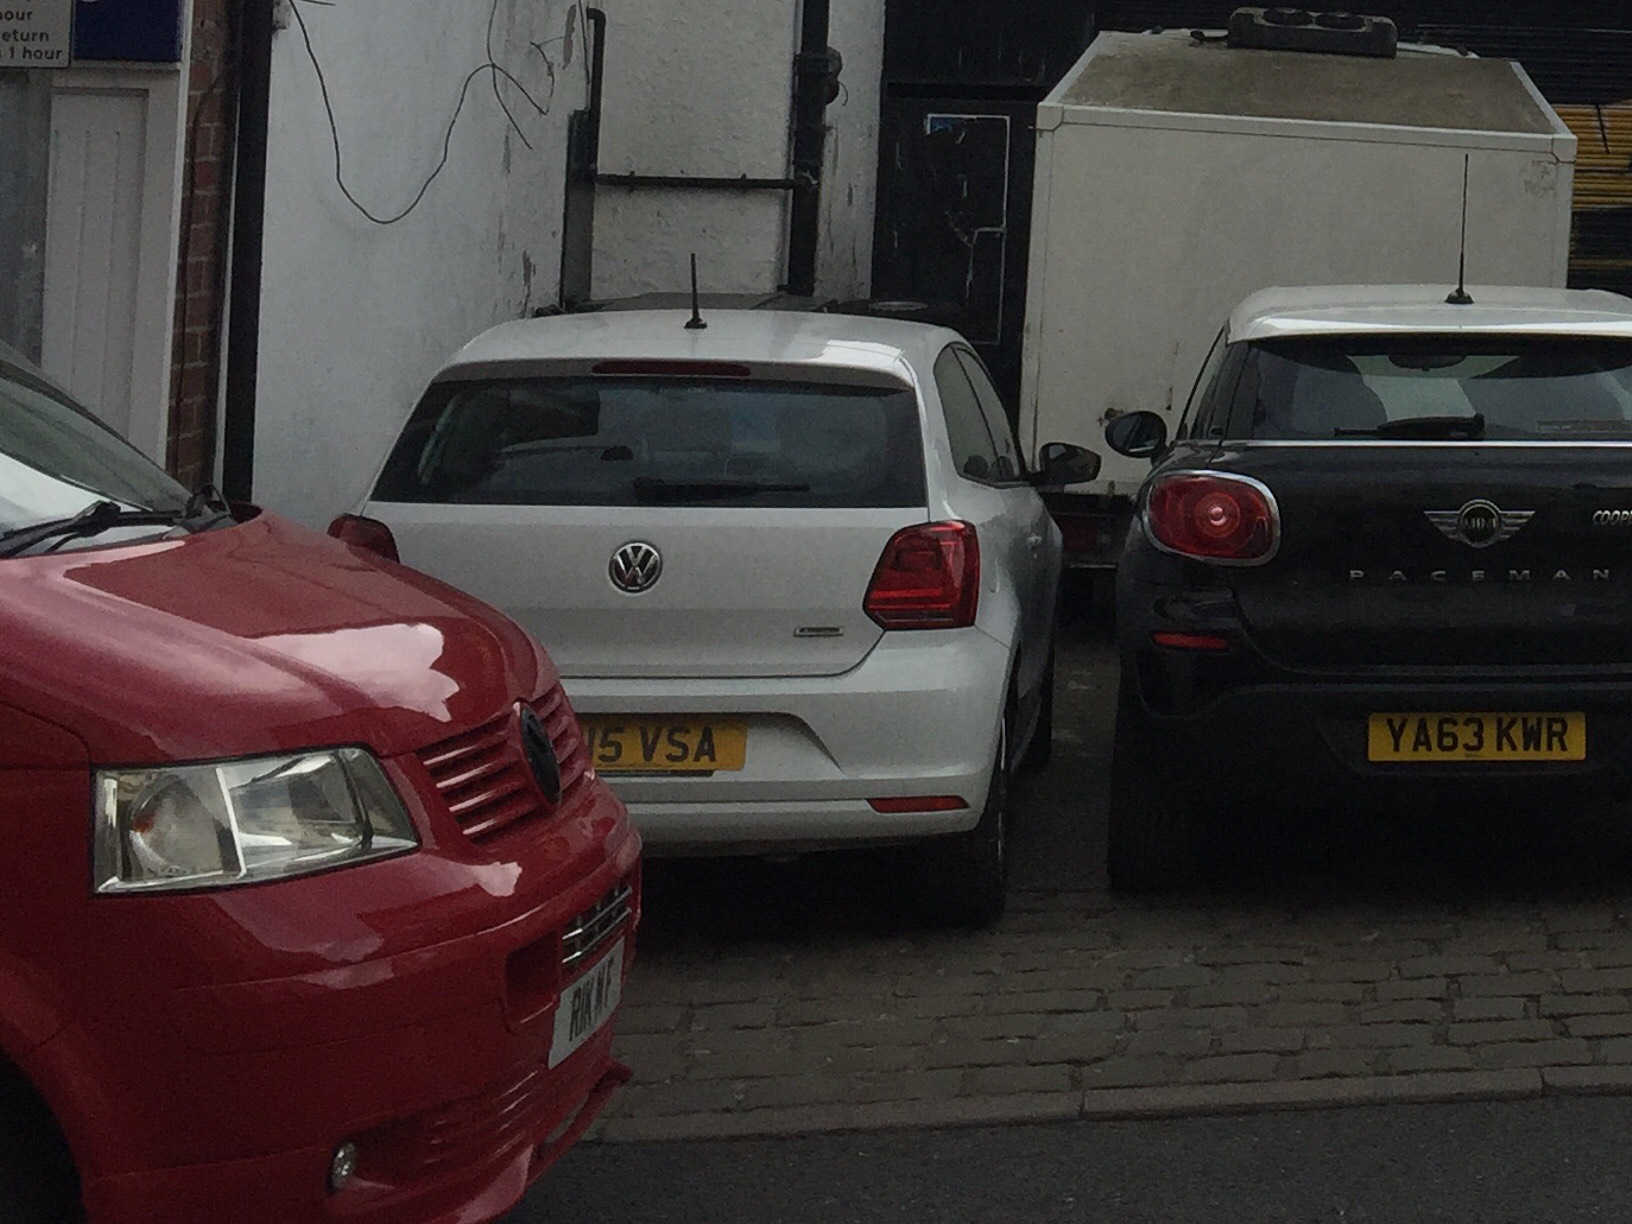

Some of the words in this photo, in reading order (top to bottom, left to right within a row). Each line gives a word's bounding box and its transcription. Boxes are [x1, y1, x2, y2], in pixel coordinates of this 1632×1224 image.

[0, 28, 49, 43] eturn
[22, 46, 63, 60] hour
[1349, 569, 1610, 581] PACEMAN
[1386, 717, 1485, 752] YA63
[1496, 717, 1569, 752] KWR
[587, 724, 623, 763] 15
[639, 724, 717, 763] VSA
